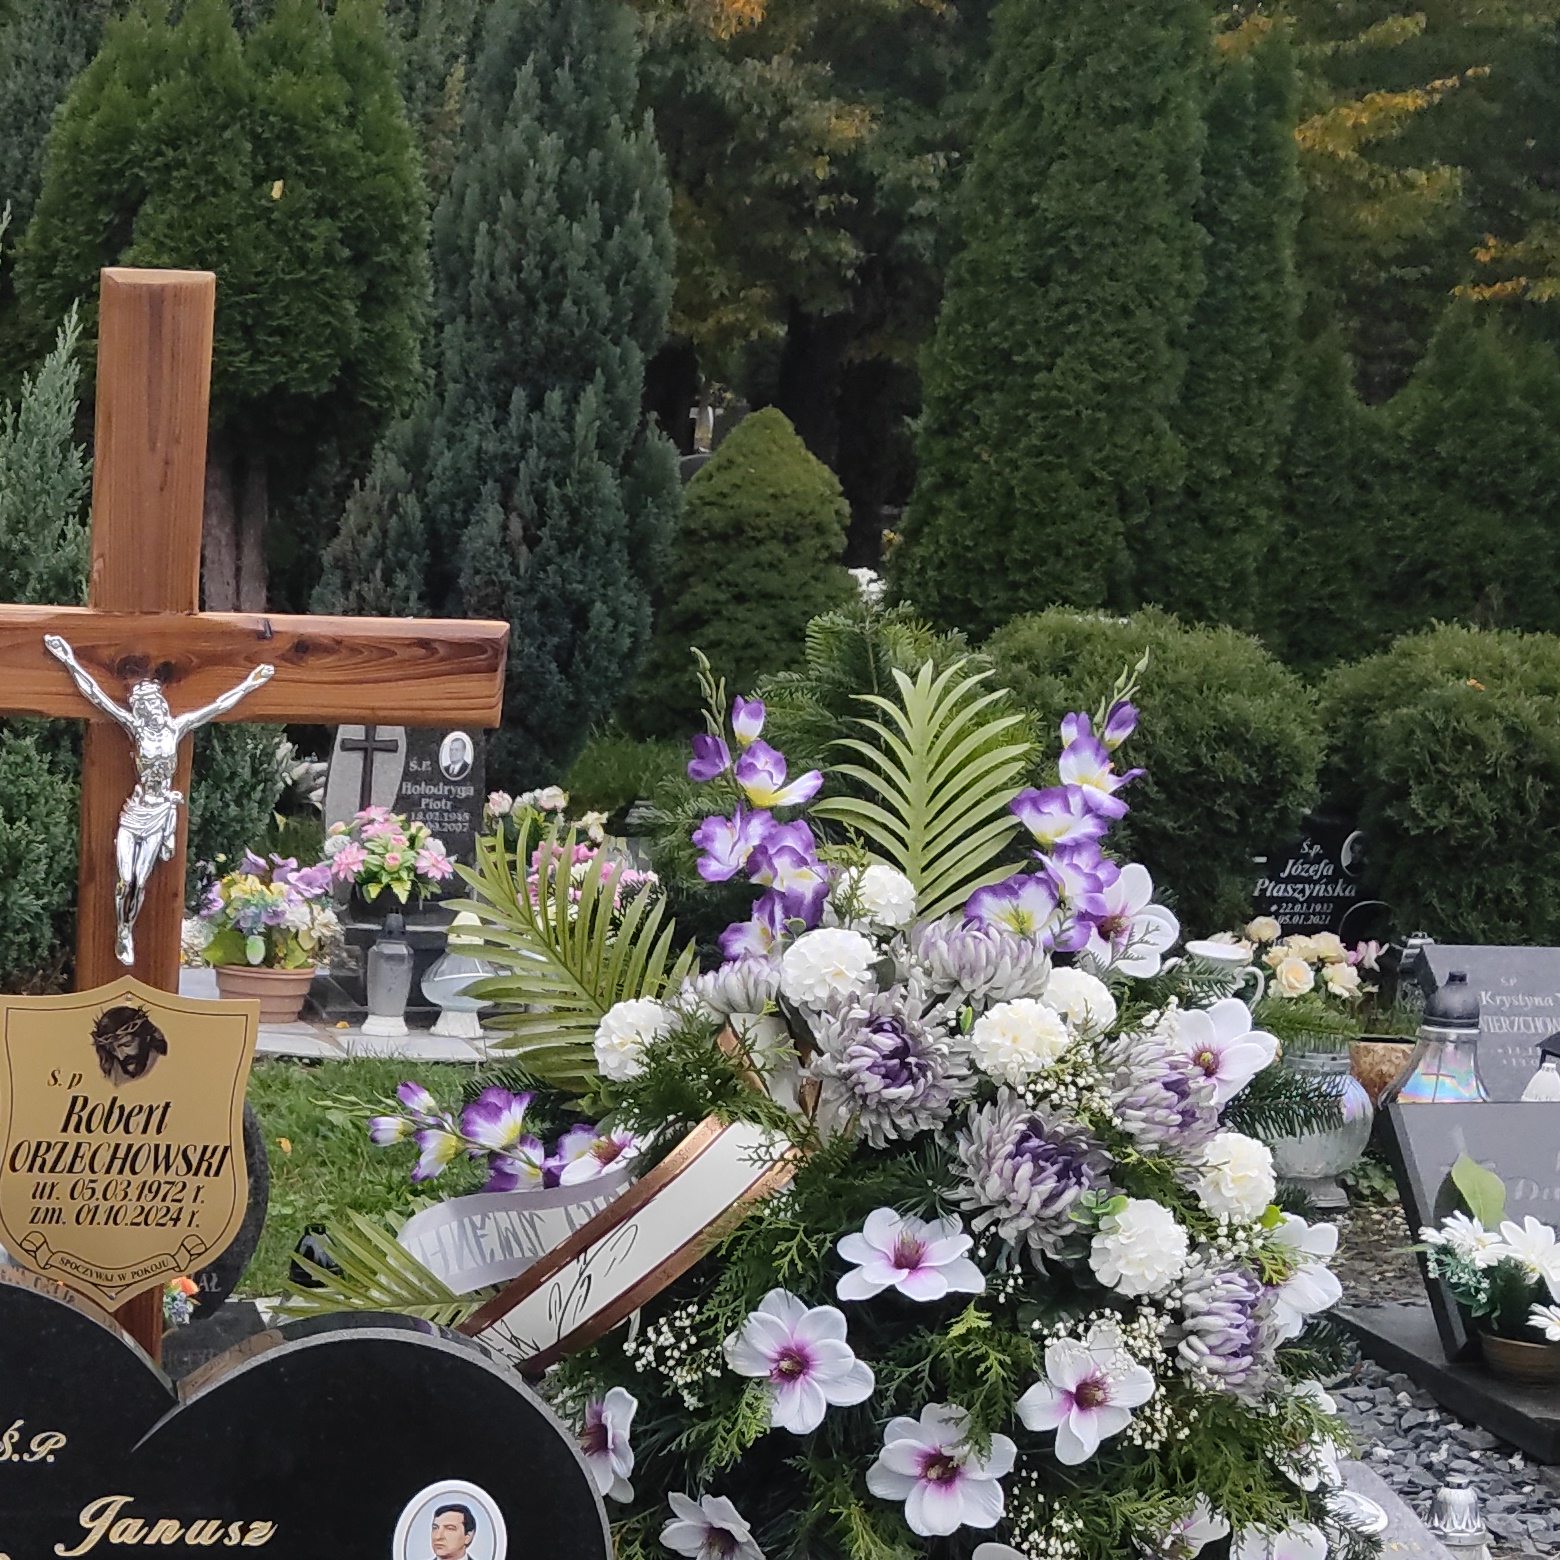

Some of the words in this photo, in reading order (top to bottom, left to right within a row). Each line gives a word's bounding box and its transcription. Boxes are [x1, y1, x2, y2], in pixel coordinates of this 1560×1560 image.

[420, 798, 454, 810] Piotr
[1279, 859, 1335, 880] Józefa
[60, 1095, 172, 1136] Robert
[9, 1140, 230, 1178] ORZECHOWSKI
[31, 1181, 61, 1201] ur.
[69, 1179, 187, 1202] 05.03.1972
[29, 1207, 66, 1226] zm.
[75, 1205, 182, 1228] 01.10.2024
[58, 1256, 115, 1283] SPOCZYWAJ
[118, 1273, 128, 1282] W
[131, 1257, 171, 1280] POKOJU
[55, 1494, 278, 1557] Janusz
